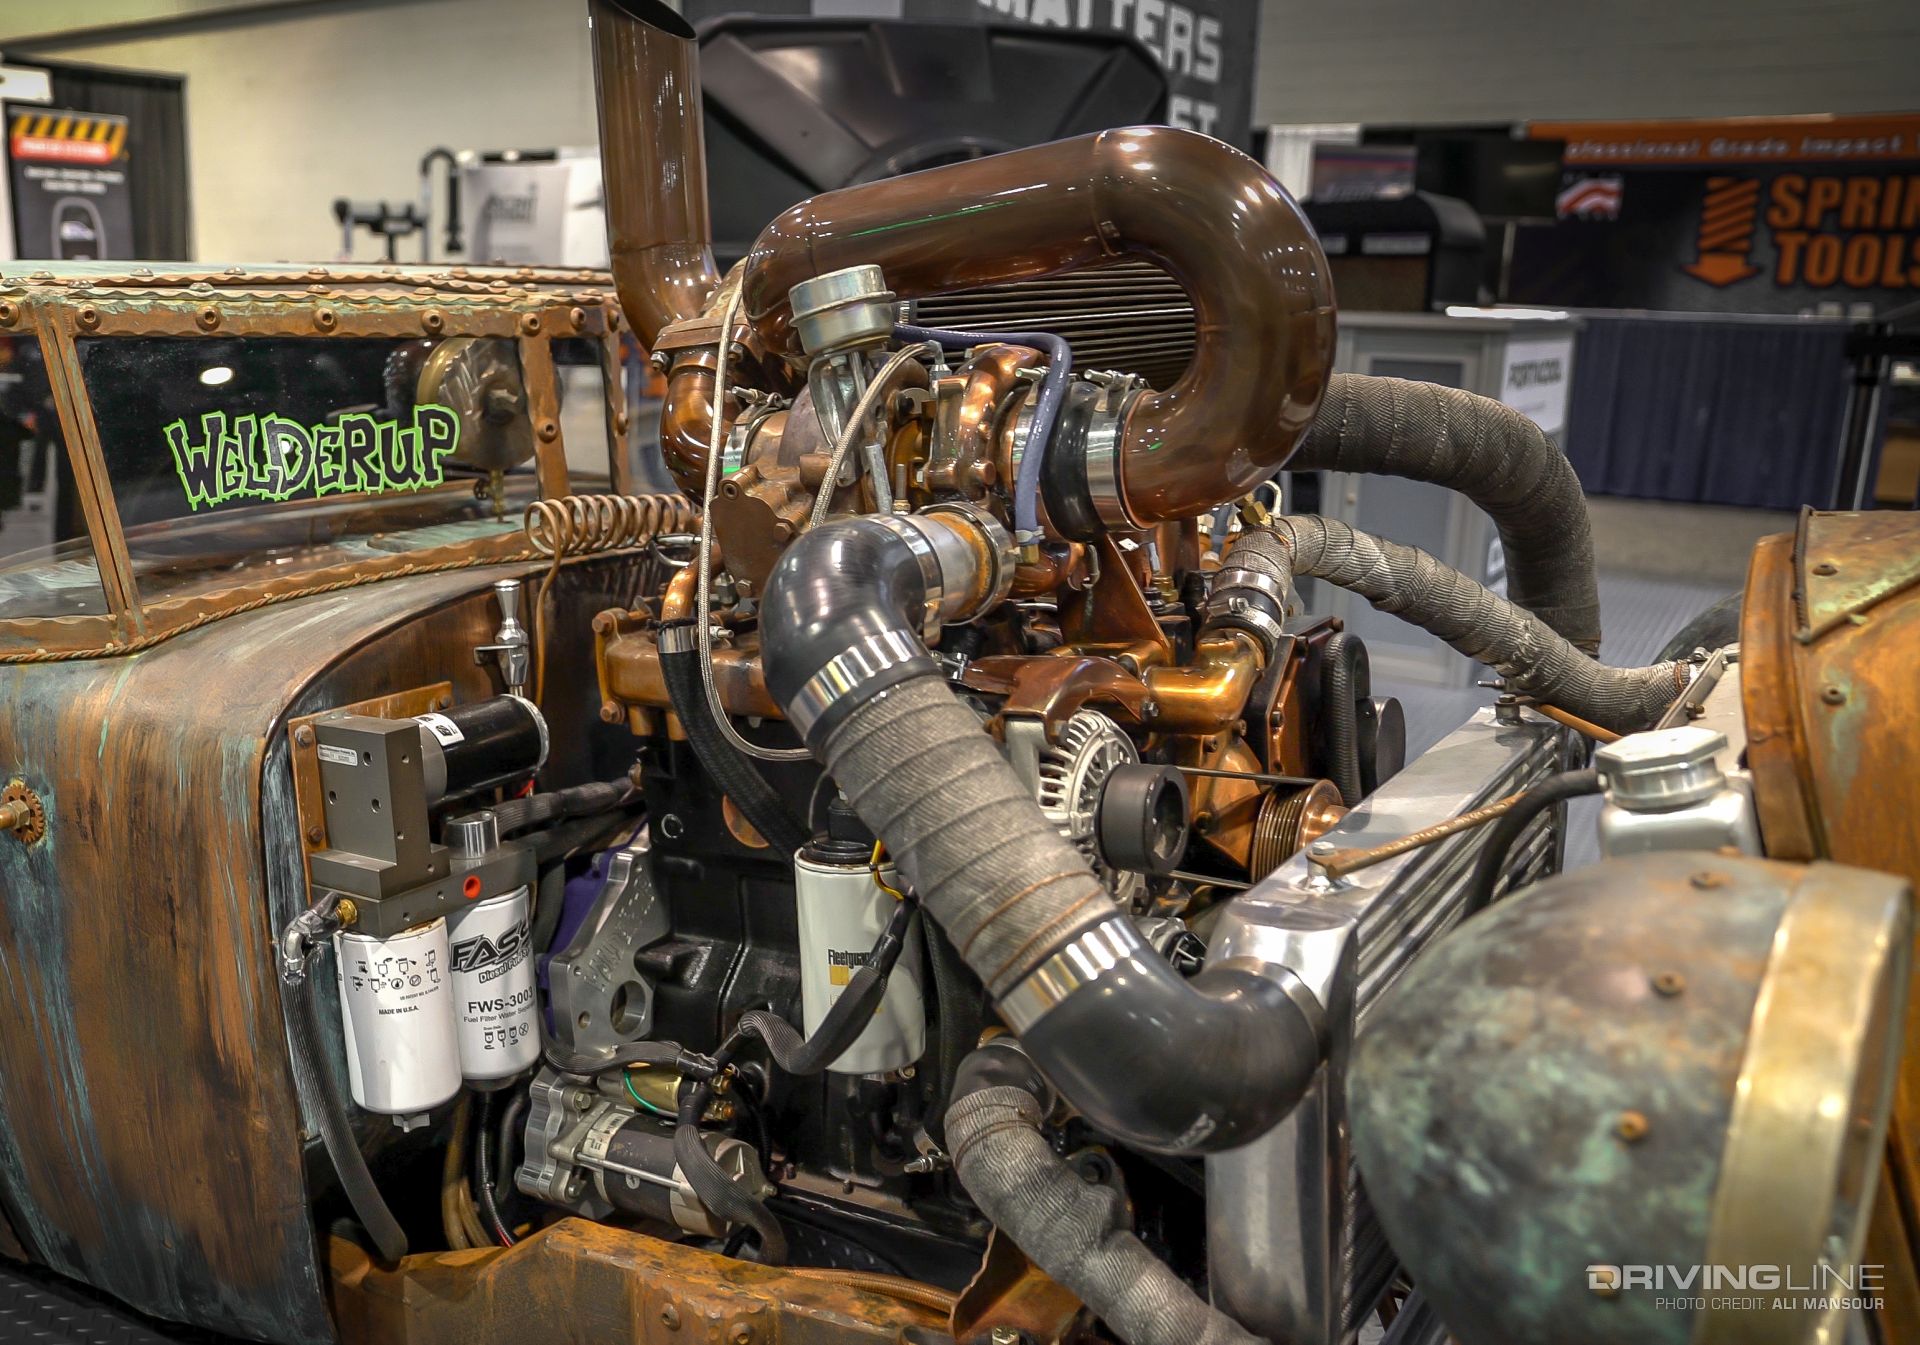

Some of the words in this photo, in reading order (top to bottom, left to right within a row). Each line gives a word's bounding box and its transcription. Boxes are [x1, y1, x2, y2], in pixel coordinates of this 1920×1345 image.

[977, 0, 1221, 83] ATERS
[828, 948, 872, 969] Fleetguar
[479, 961, 508, 984] Diesel
[468, 986, 533, 1014] FWS-3003
[480, 1014, 497, 1022] Filter
[498, 1010, 517, 1020] Water
